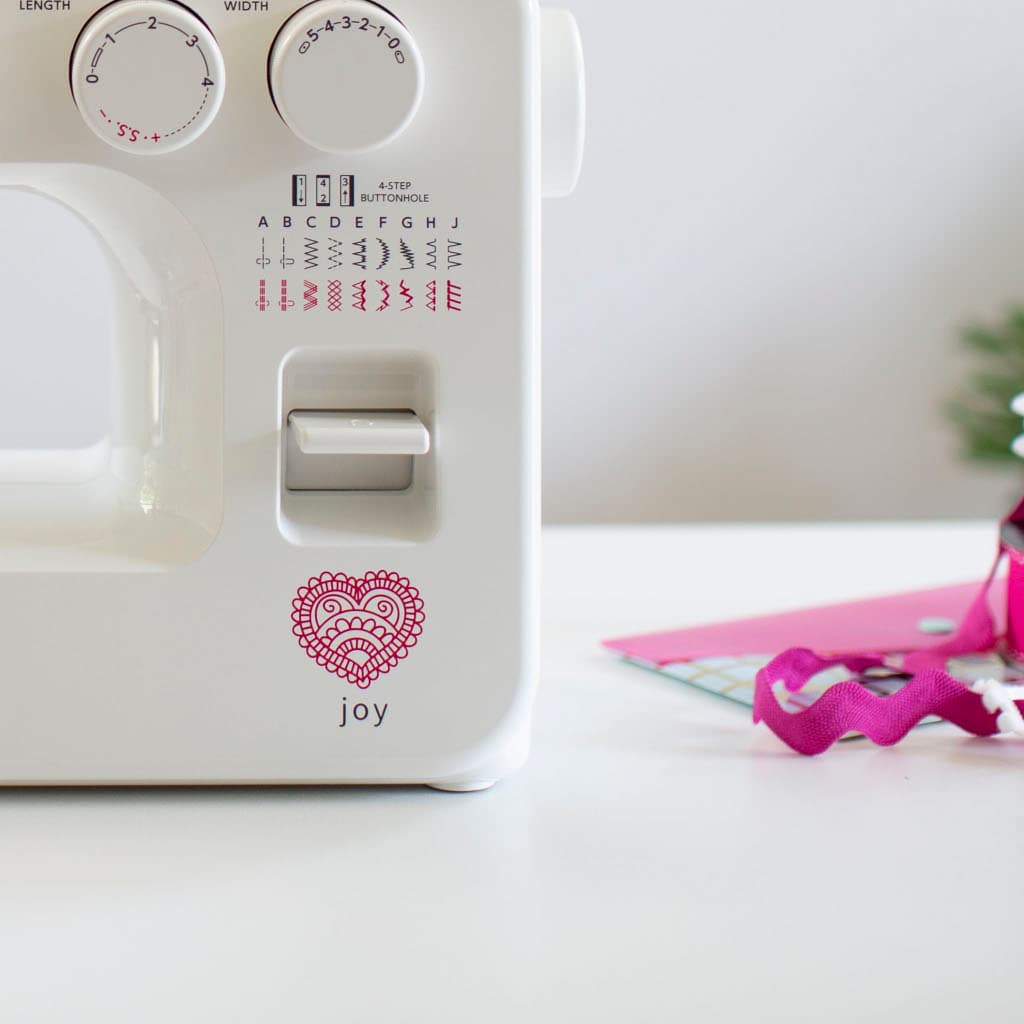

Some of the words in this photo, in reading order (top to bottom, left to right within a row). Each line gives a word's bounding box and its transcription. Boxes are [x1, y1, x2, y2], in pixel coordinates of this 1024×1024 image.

[19, 0, 71, 11] LENGTH
[224, 0, 269, 12] WIDTH
[147, 16, 158, 30] 2
[105, 33, 116, 44] 1
[185, 34, 199, 48] 3
[85, 74, 99, 84] 0
[201, 77, 215, 87] 4
[378, 181, 412, 190] 4-STEP
[360, 193, 430, 203] BUTTONHOLE
[258, 216, 269, 228] A
[283, 216, 292, 228] B
[306, 216, 317, 228] C
[330, 216, 341, 228] D
[355, 216, 364, 228] E
[379, 216, 387, 228] F
[401, 216, 413, 228] G
[426, 216, 436, 228] H
[451, 216, 459, 228] J
[339, 697, 388, 727] joy
